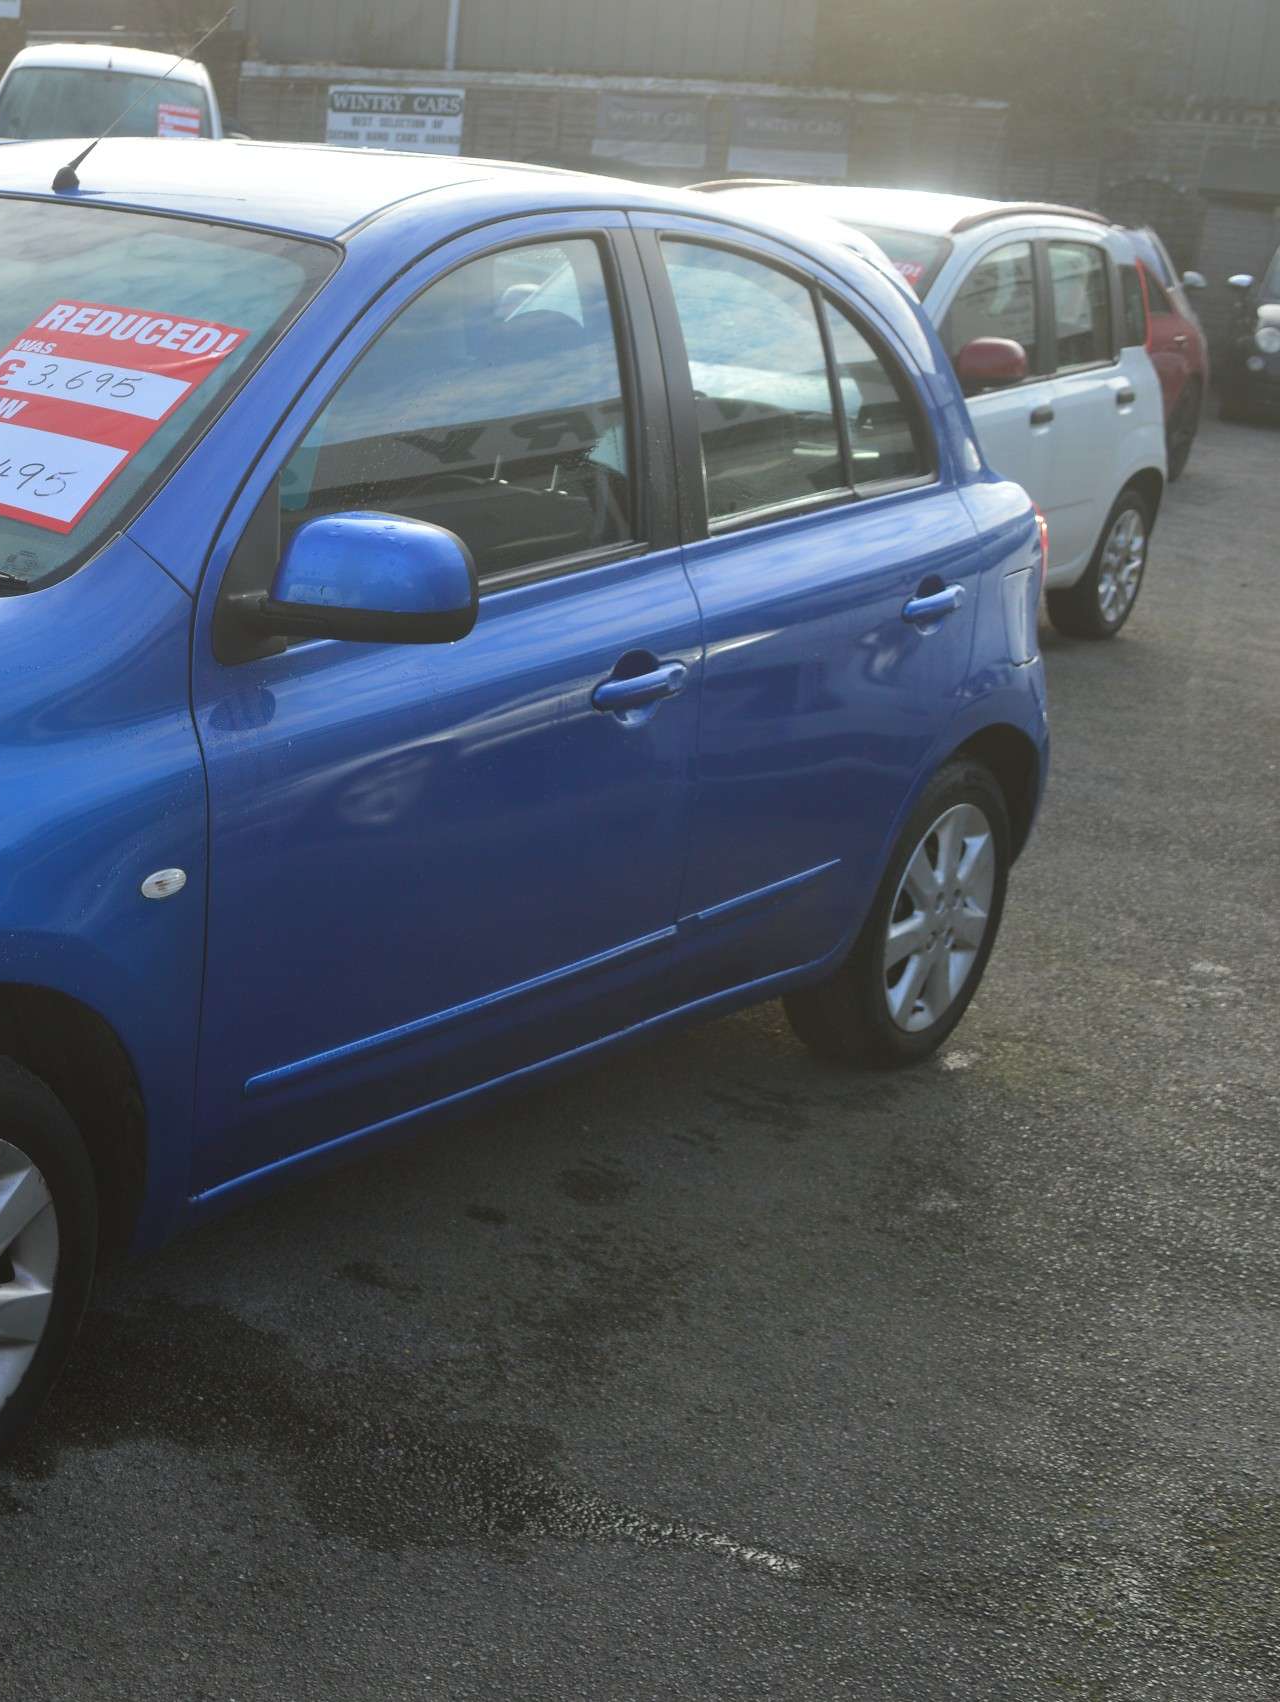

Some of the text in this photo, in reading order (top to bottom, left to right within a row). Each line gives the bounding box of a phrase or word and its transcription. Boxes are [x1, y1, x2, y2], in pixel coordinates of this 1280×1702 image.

[333, 94, 462, 114] WINTRY CARS
[35, 303, 238, 359] REDUCED!
[14, 338, 57, 355] WAS
